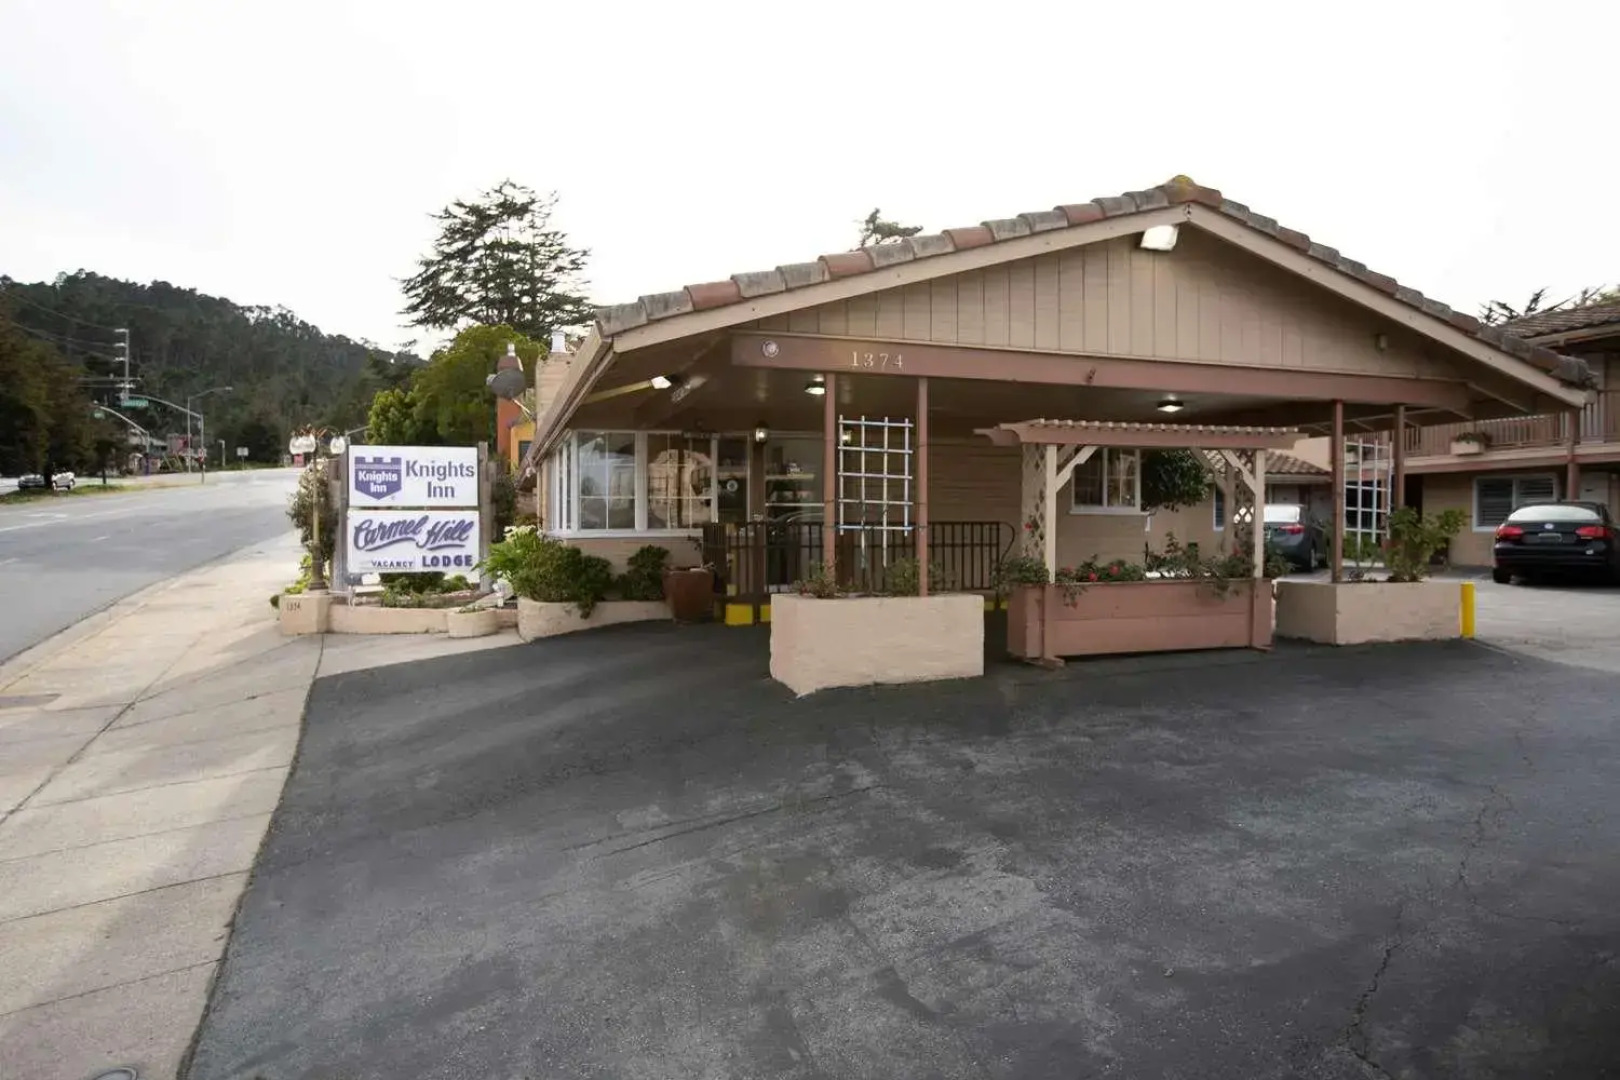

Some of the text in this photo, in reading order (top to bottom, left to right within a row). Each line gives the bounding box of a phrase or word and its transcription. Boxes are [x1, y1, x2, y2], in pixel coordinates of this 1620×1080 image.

[851, 351, 903, 369] 1374
[358, 470, 398, 483] Knights
[406, 460, 475, 481] Knights
[370, 482, 387, 493] Inn
[428, 481, 455, 498] Inn
[354, 515, 474, 551] Carmel Hill
[371, 560, 414, 569] VACANCY
[422, 555, 474, 568] LODGE
